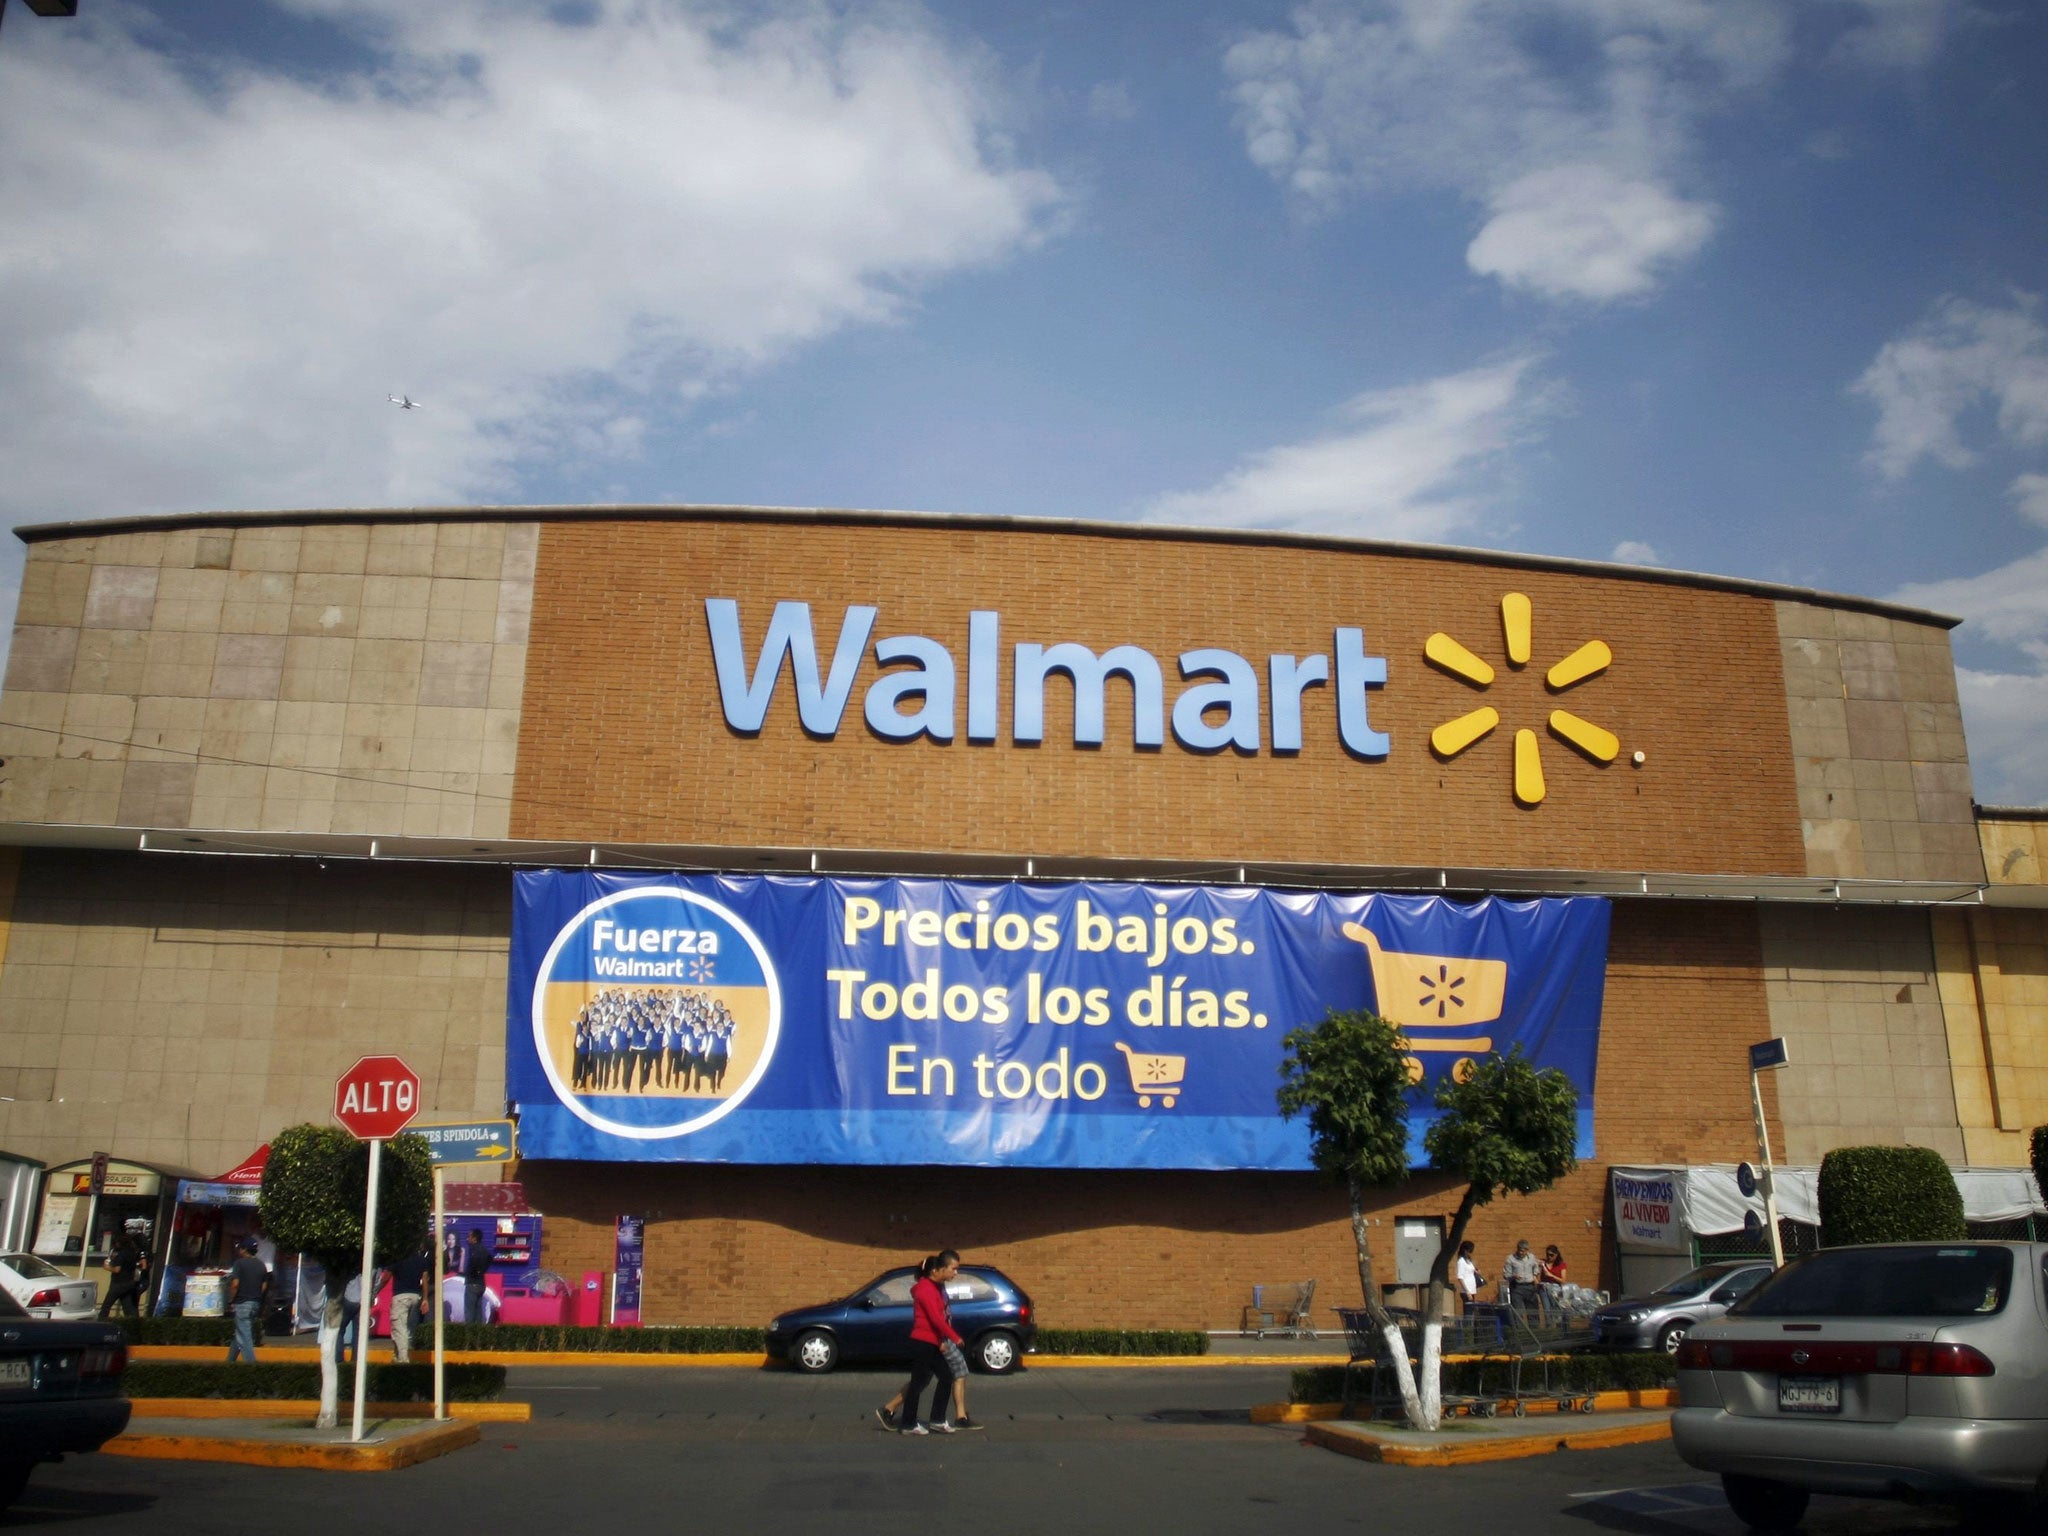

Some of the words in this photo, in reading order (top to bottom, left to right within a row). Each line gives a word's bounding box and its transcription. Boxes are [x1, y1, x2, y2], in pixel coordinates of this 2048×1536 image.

[705, 597, 1392, 760] Walmart
[592, 920, 719, 955] Fuerza
[842, 897, 1061, 953] Precios
[1076, 900, 1257, 968] bajos.
[594, 957, 684, 978] Walmart
[826, 968, 1010, 1025] Todos
[1027, 972, 1111, 1027] los
[1126, 975, 1269, 1030] días.
[886, 1044, 955, 1097] En
[972, 1047, 1108, 1101] todo
[340, 1079, 413, 1114] ALTO
[443, 1128, 490, 1142] SPINDOLA
[1622, 1201, 1636, 1221] AL
[1635, 1202, 1671, 1225] VIVERO
